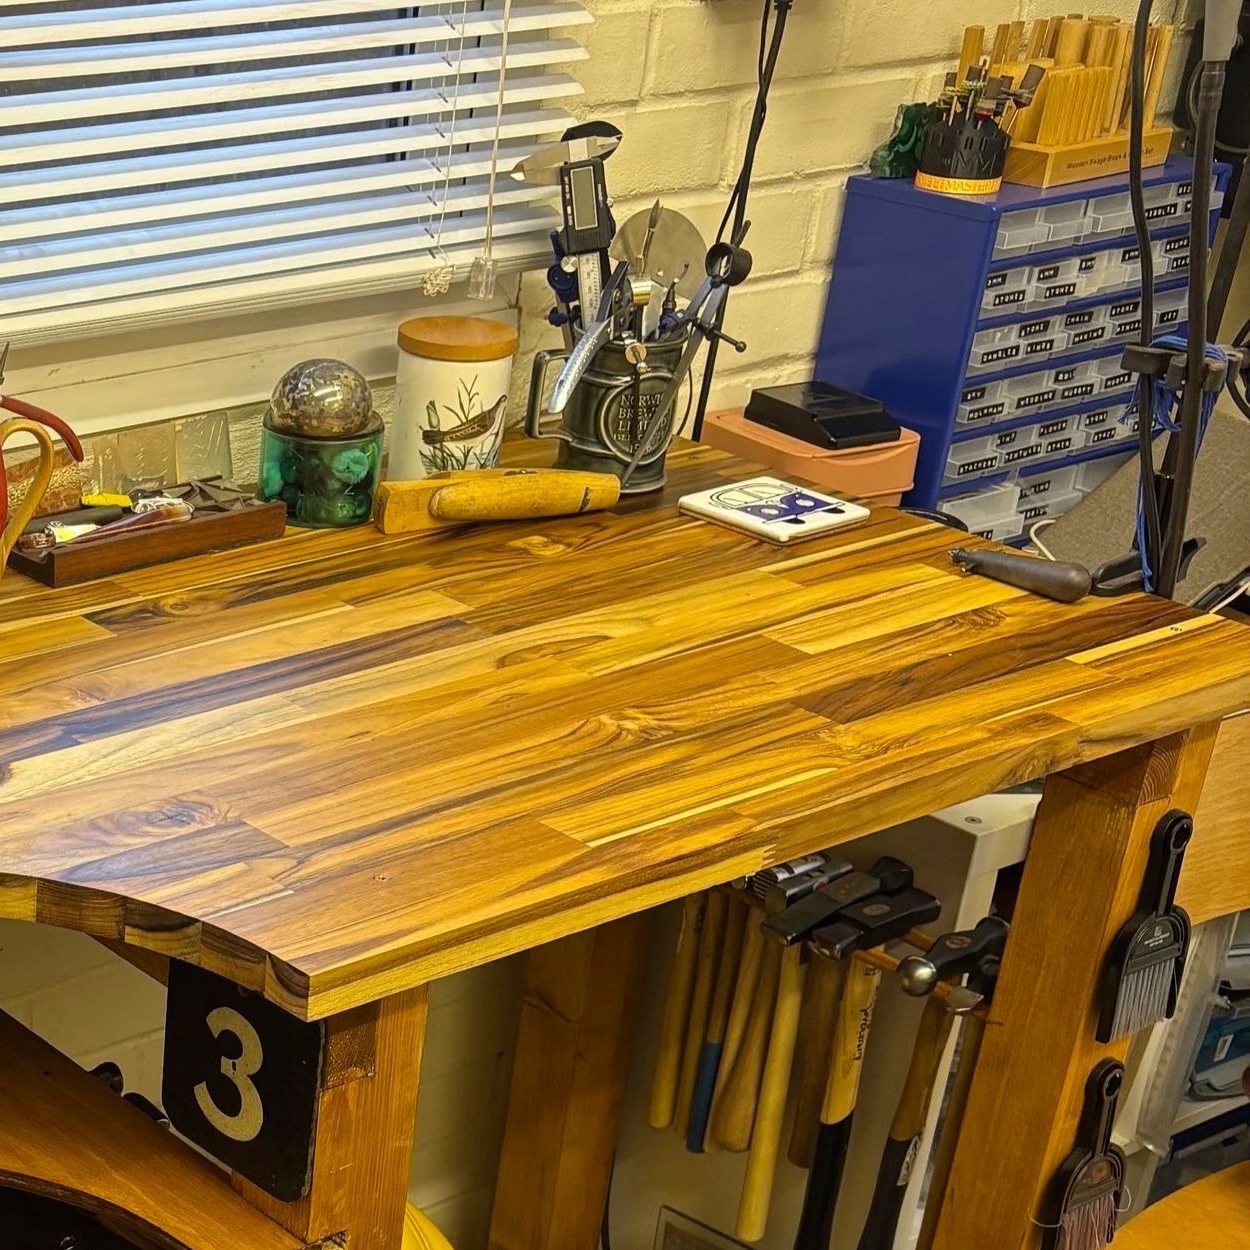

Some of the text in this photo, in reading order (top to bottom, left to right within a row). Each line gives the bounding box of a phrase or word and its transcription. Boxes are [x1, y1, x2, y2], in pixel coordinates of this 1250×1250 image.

[1045, 285, 1074, 297] STONES
[995, 293, 1024, 304] STONES
[959, 459, 996, 474] STACKERS
[194, 1006, 263, 1142] 3
